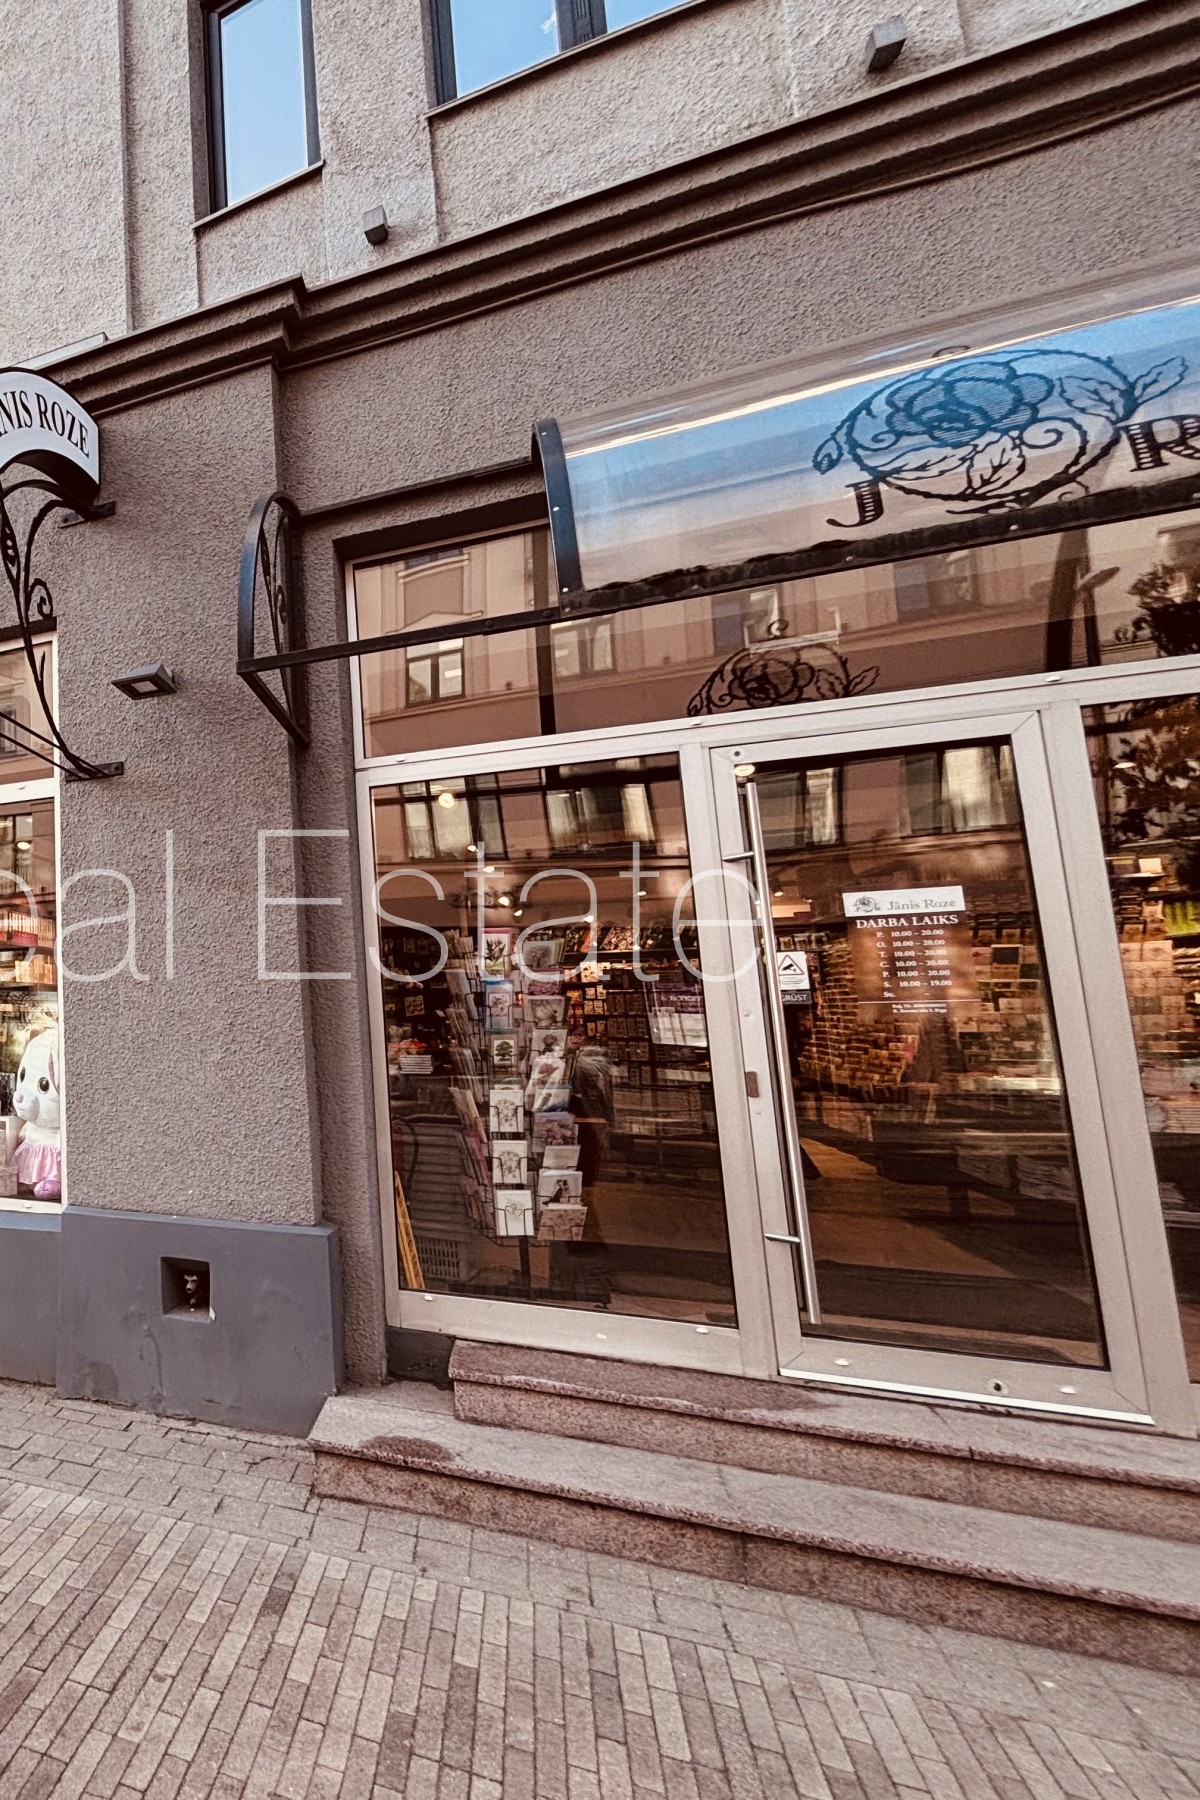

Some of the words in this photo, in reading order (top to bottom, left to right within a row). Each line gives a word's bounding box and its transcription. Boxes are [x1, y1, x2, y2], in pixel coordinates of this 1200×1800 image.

[34, 392, 90, 458] ROZE
[887, 900, 920, 911] Jānis
[924, 898, 956, 909] Roze
[856, 917, 909, 928] DARBA
[912, 914, 958, 926] LAIKS
